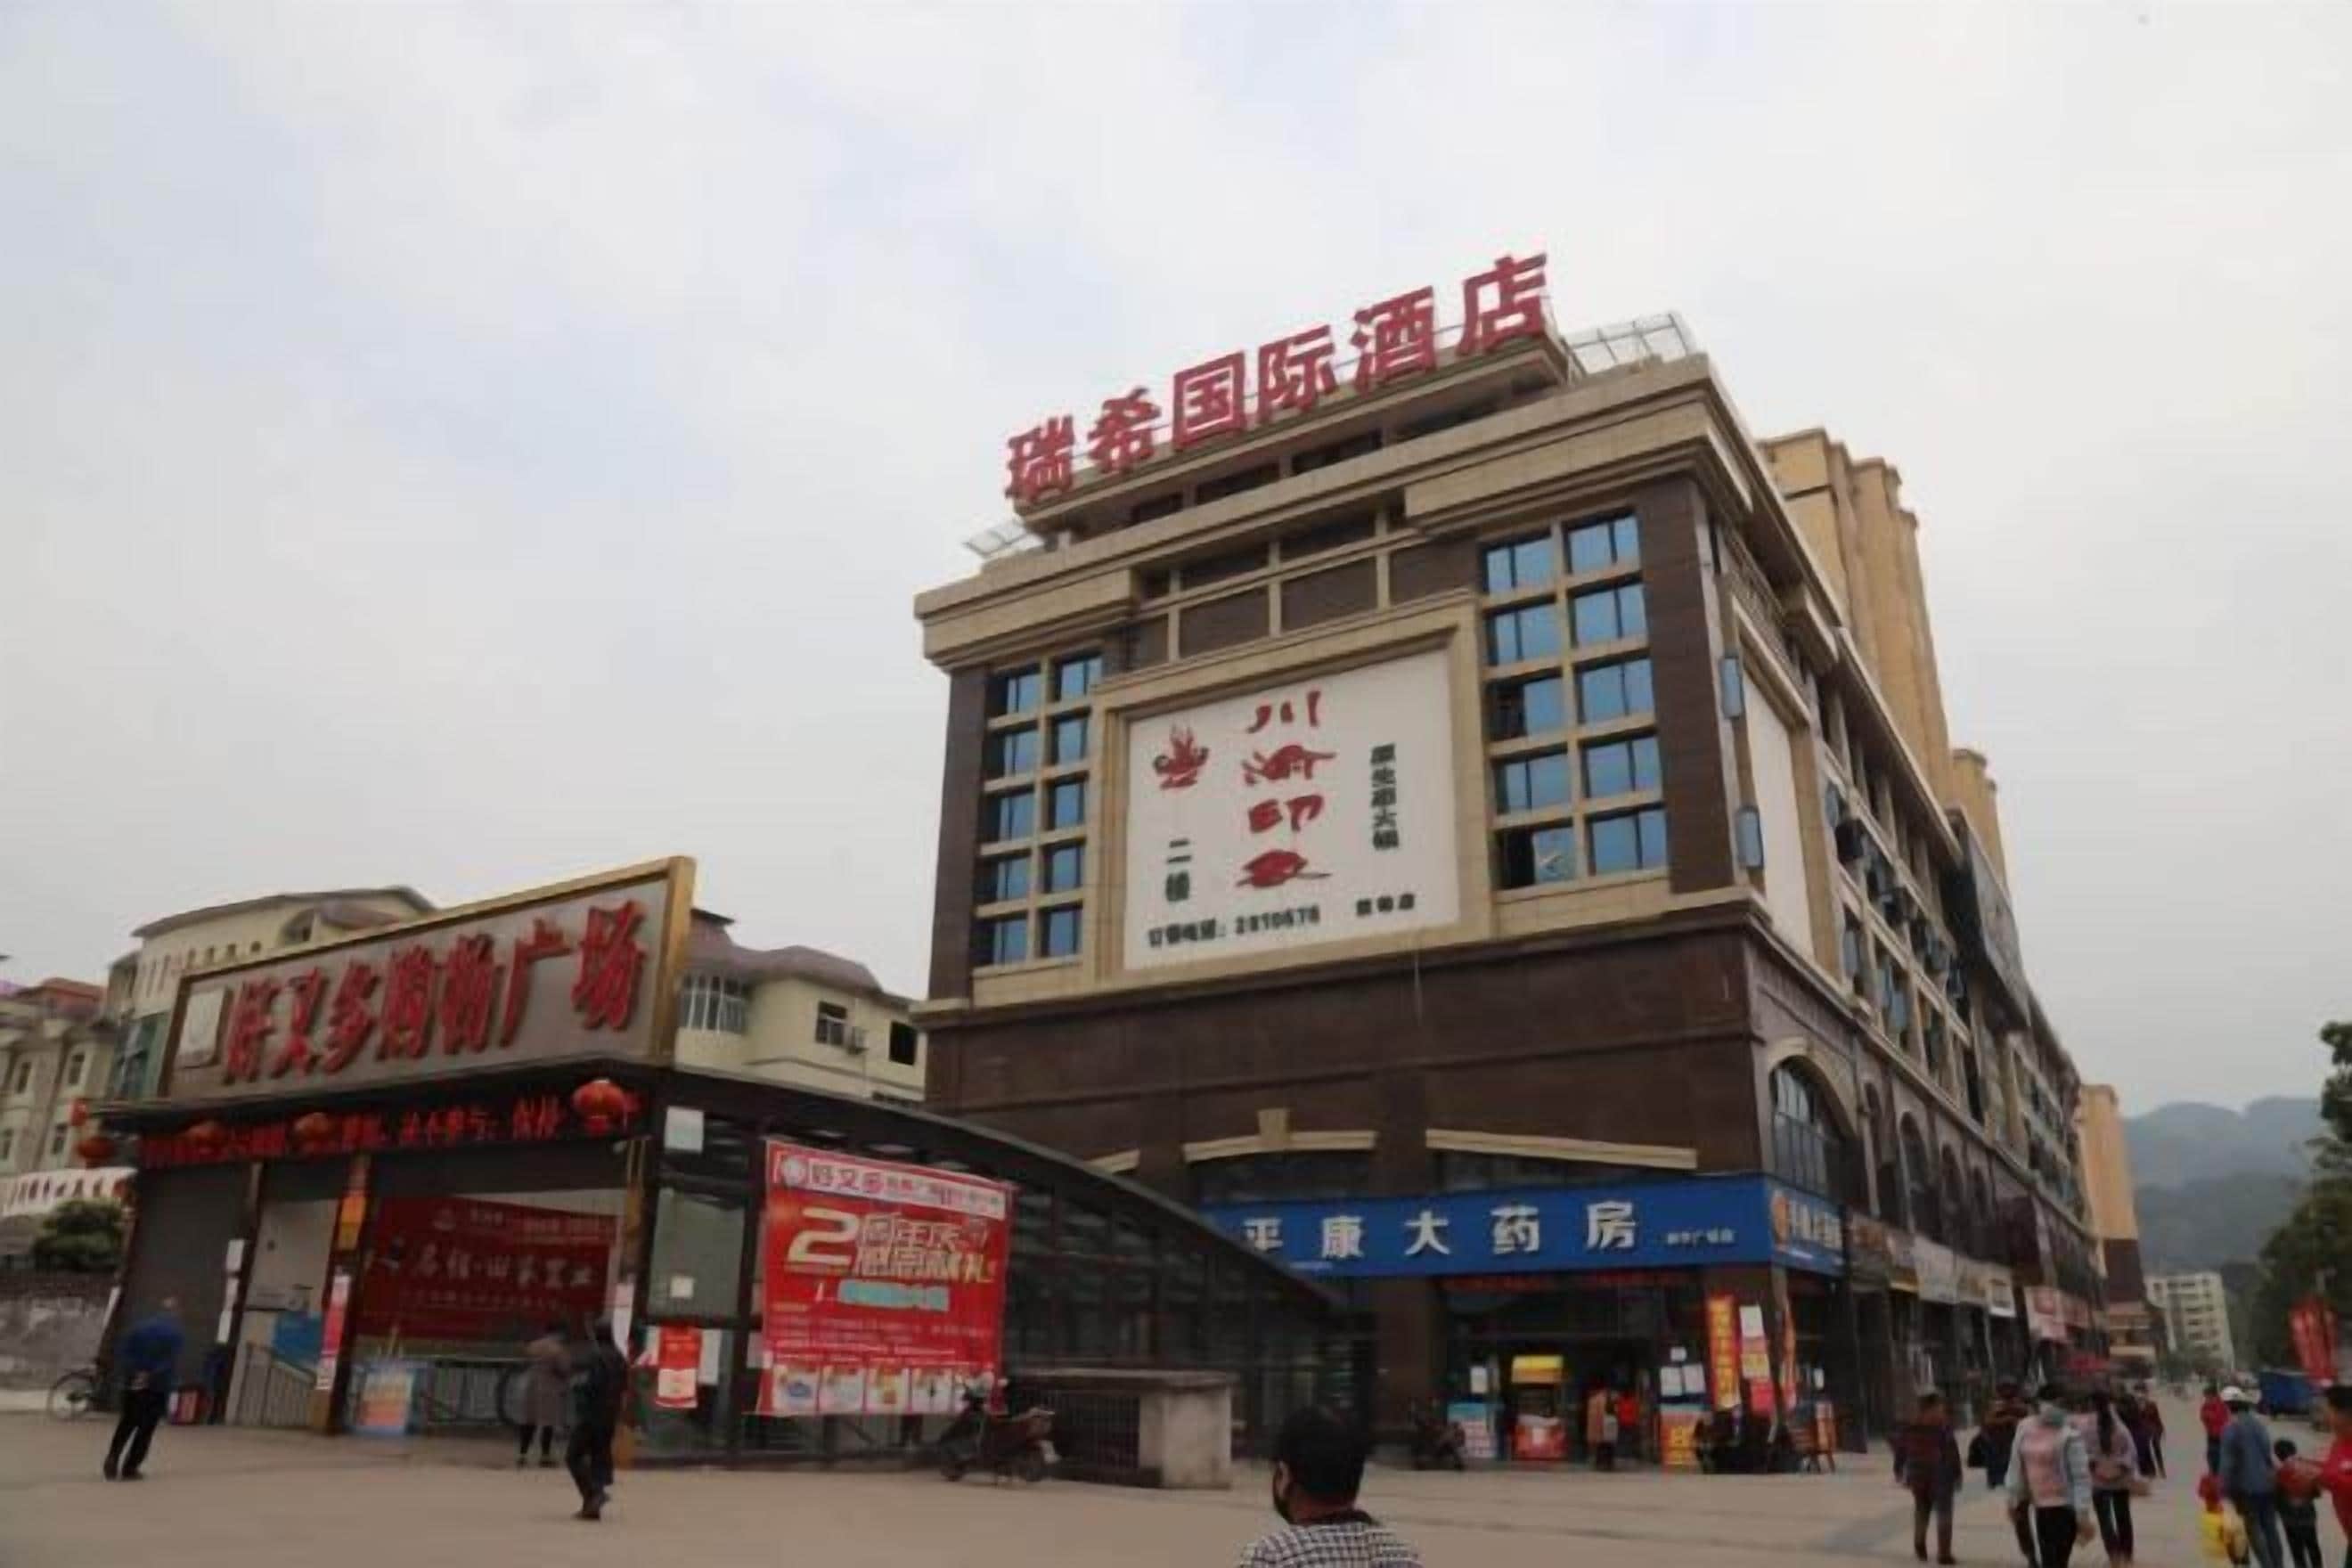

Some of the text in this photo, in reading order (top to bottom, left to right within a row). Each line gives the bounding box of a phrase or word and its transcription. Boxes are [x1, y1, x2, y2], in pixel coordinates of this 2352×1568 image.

[1005, 253, 1547, 503] 瑞希国际酒店
[1244, 1201, 1636, 1258] 平康大药房
